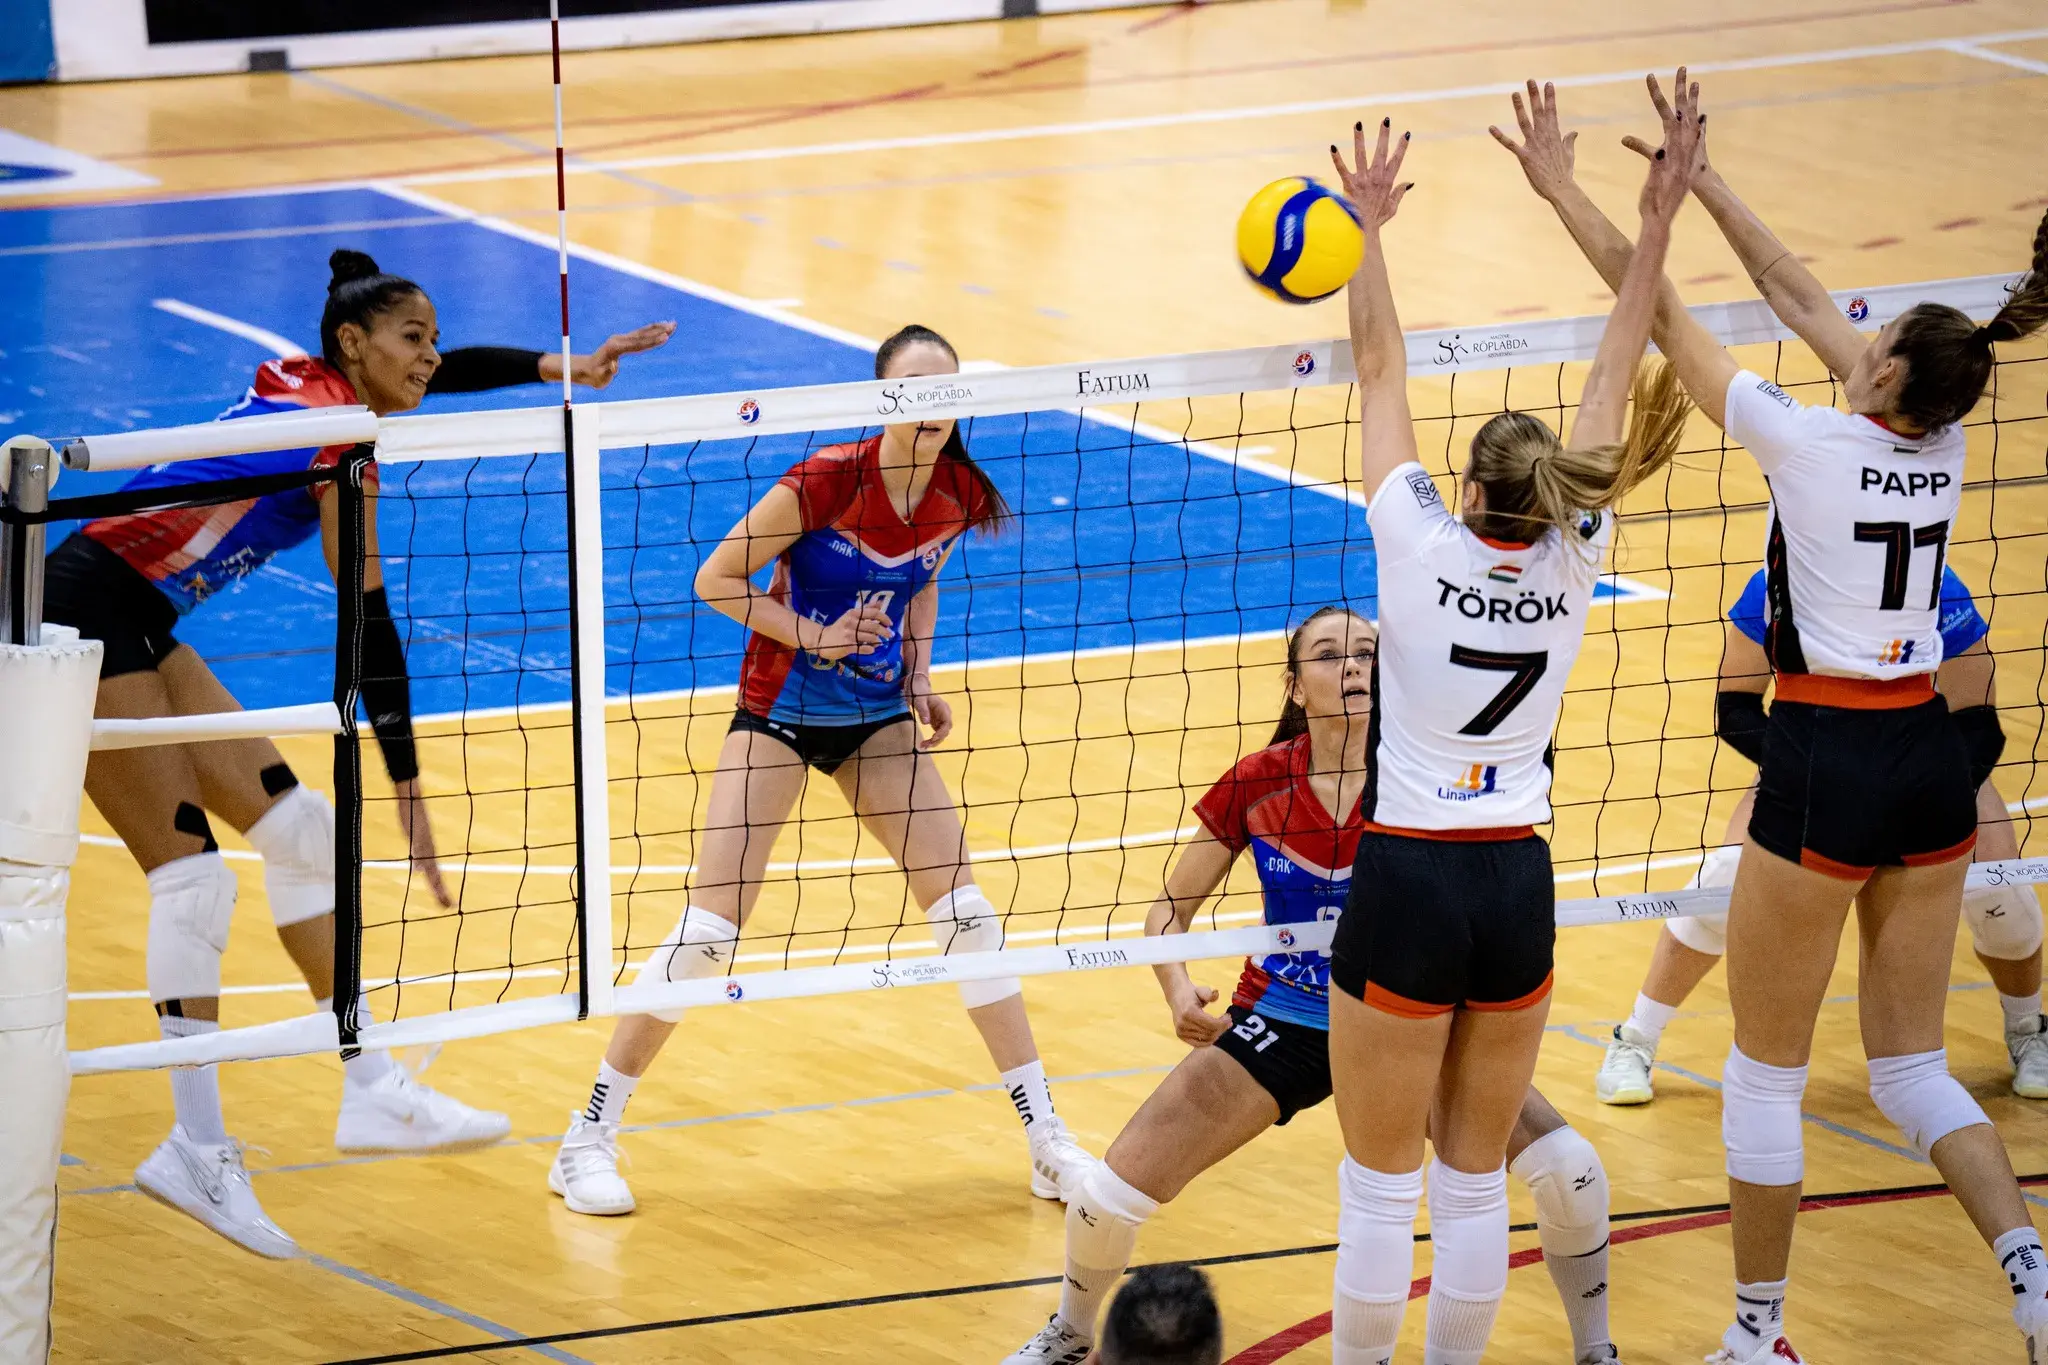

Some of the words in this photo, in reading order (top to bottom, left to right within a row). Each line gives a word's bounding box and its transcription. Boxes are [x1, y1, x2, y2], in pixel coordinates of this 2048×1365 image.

[1473, 338, 1528, 353] RÖPLABDA
[1861, 466, 1951, 497] PAPP
[1437, 577, 1569, 624] TÖRÖK
[1450, 643, 1548, 736] 7
[1232, 1015, 1280, 1053] 21
[2016, 1245, 2038, 1270] nine
